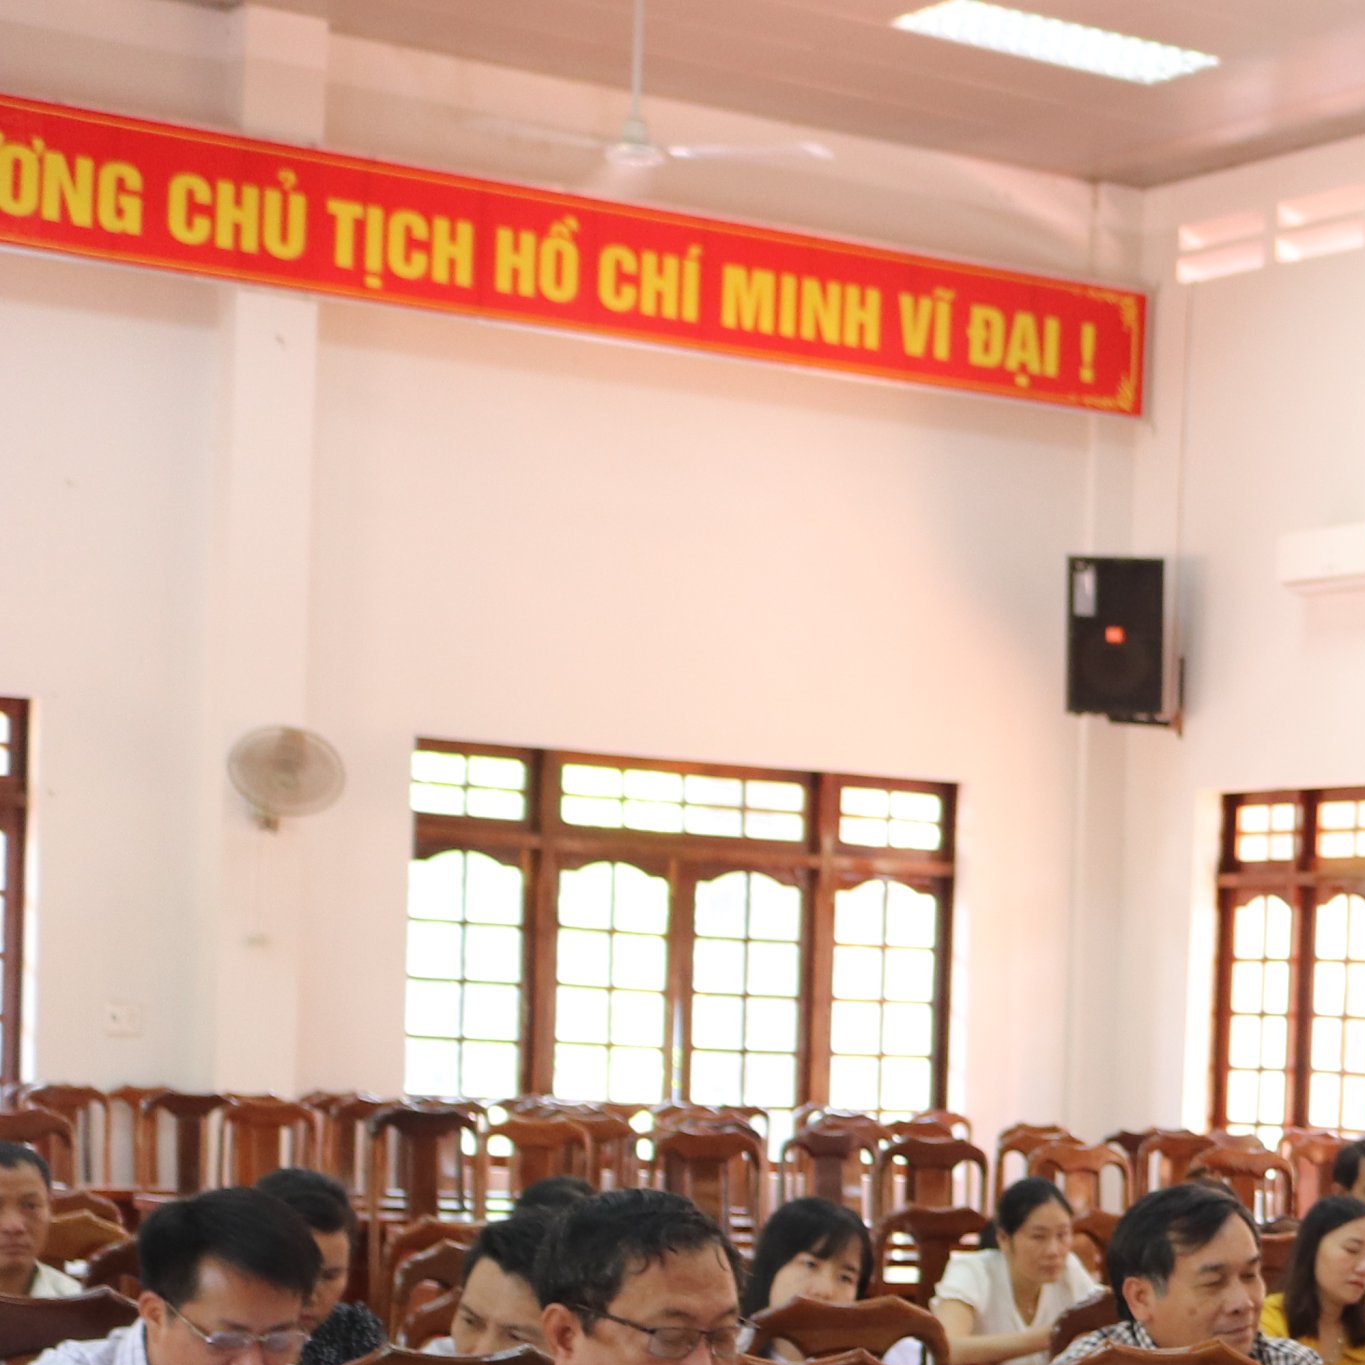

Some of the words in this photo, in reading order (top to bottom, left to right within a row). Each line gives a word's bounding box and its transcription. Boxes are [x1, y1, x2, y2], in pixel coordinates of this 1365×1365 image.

[0, 131, 143, 237] ƠNG
[167, 168, 307, 260] CHỦ
[326, 199, 475, 289] TỊCH
[494, 216, 580, 304] HỒ
[597, 243, 702, 324] CHÍ
[720, 262, 882, 352] MINH
[898, 287, 955, 363] VĨ
[966, 303, 1061, 388] ĐẠI
[1079, 322, 1096, 384] !
